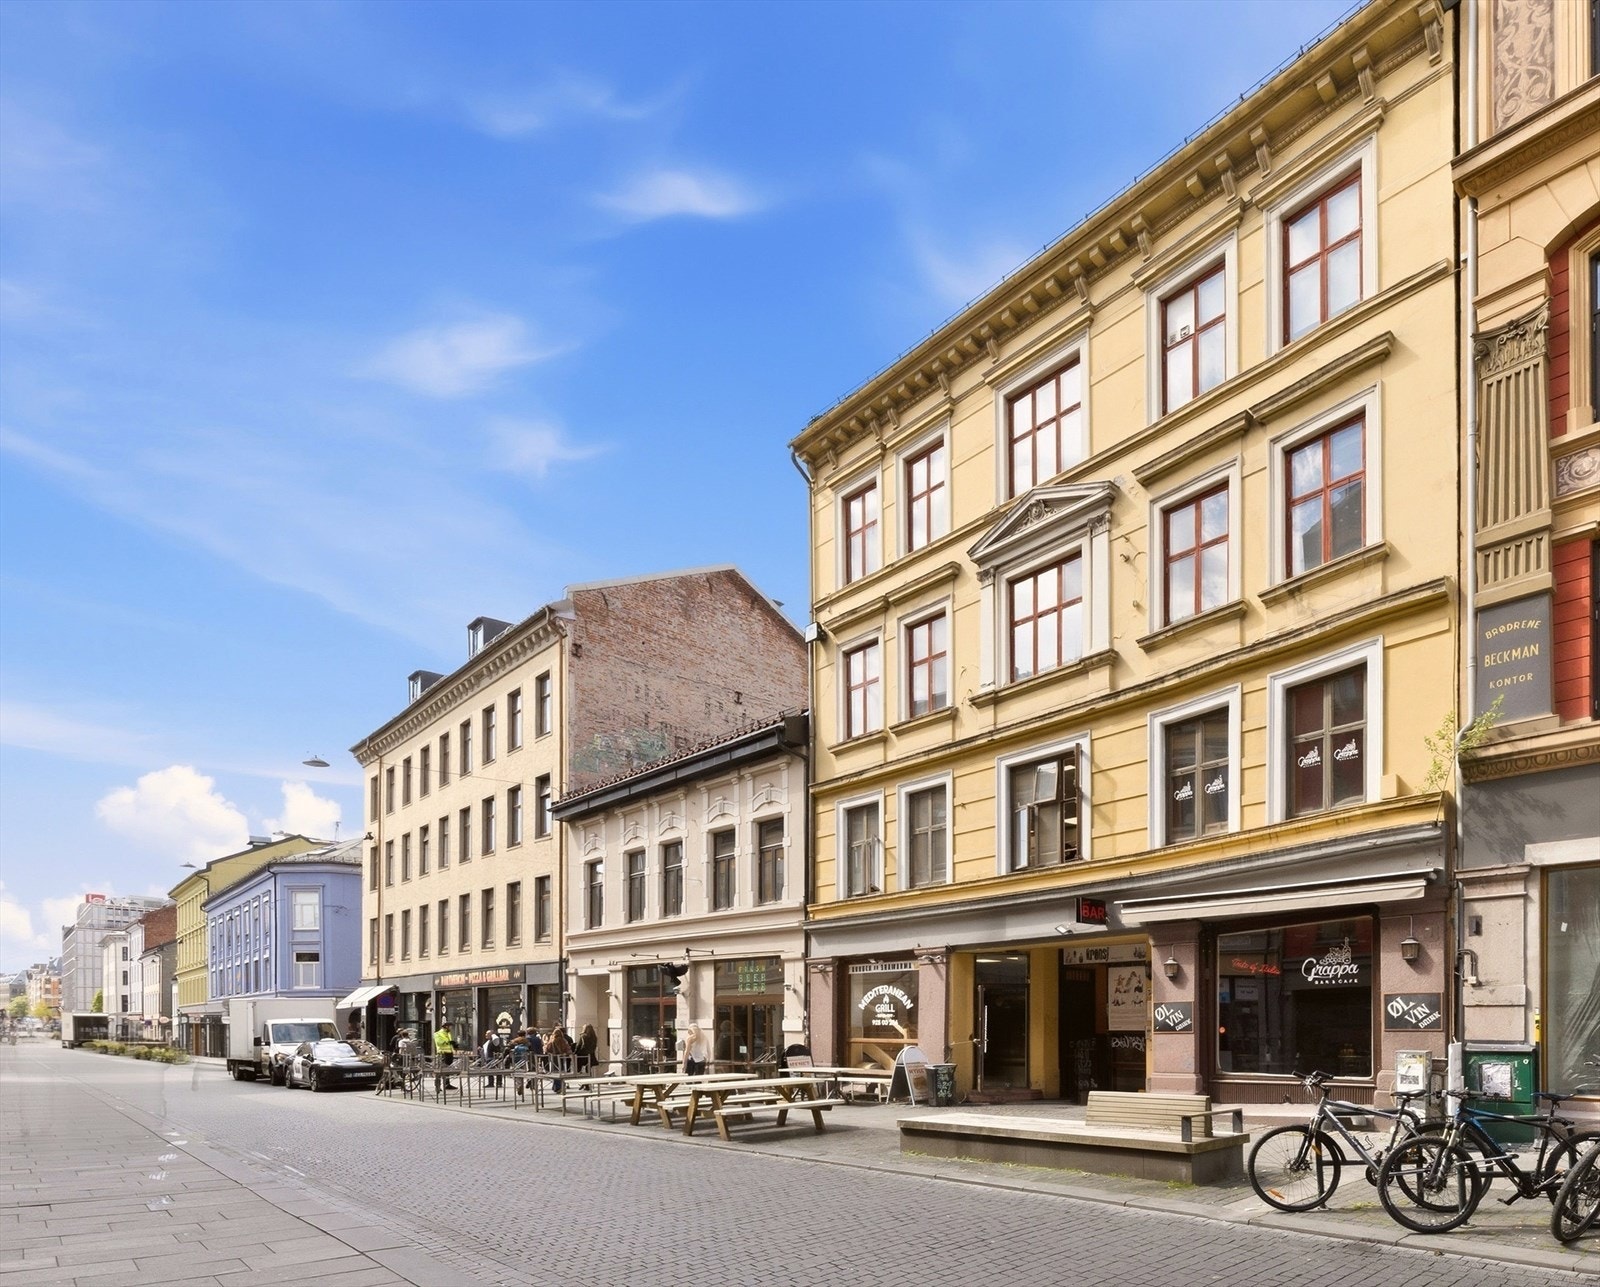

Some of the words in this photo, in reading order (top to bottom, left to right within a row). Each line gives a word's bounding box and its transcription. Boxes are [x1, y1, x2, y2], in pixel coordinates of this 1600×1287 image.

[1485, 619, 1541, 639] BRØDRENE
[1484, 643, 1540, 667] BECKMAN
[1489, 672, 1533, 689] KONTOR
[1082, 904, 1105, 919] BAR
[738, 973, 766, 982] BEER
[1301, 957, 1360, 982] Grappa
[858, 984, 914, 1010] MEDITERANEAN
[875, 1003, 896, 1013] GRILL
[1154, 1004, 1175, 1022] ØL
[1387, 996, 1416, 1019] ØL
[1404, 1003, 1431, 1024] VIN
[1165, 1009, 1184, 1027] VIN
